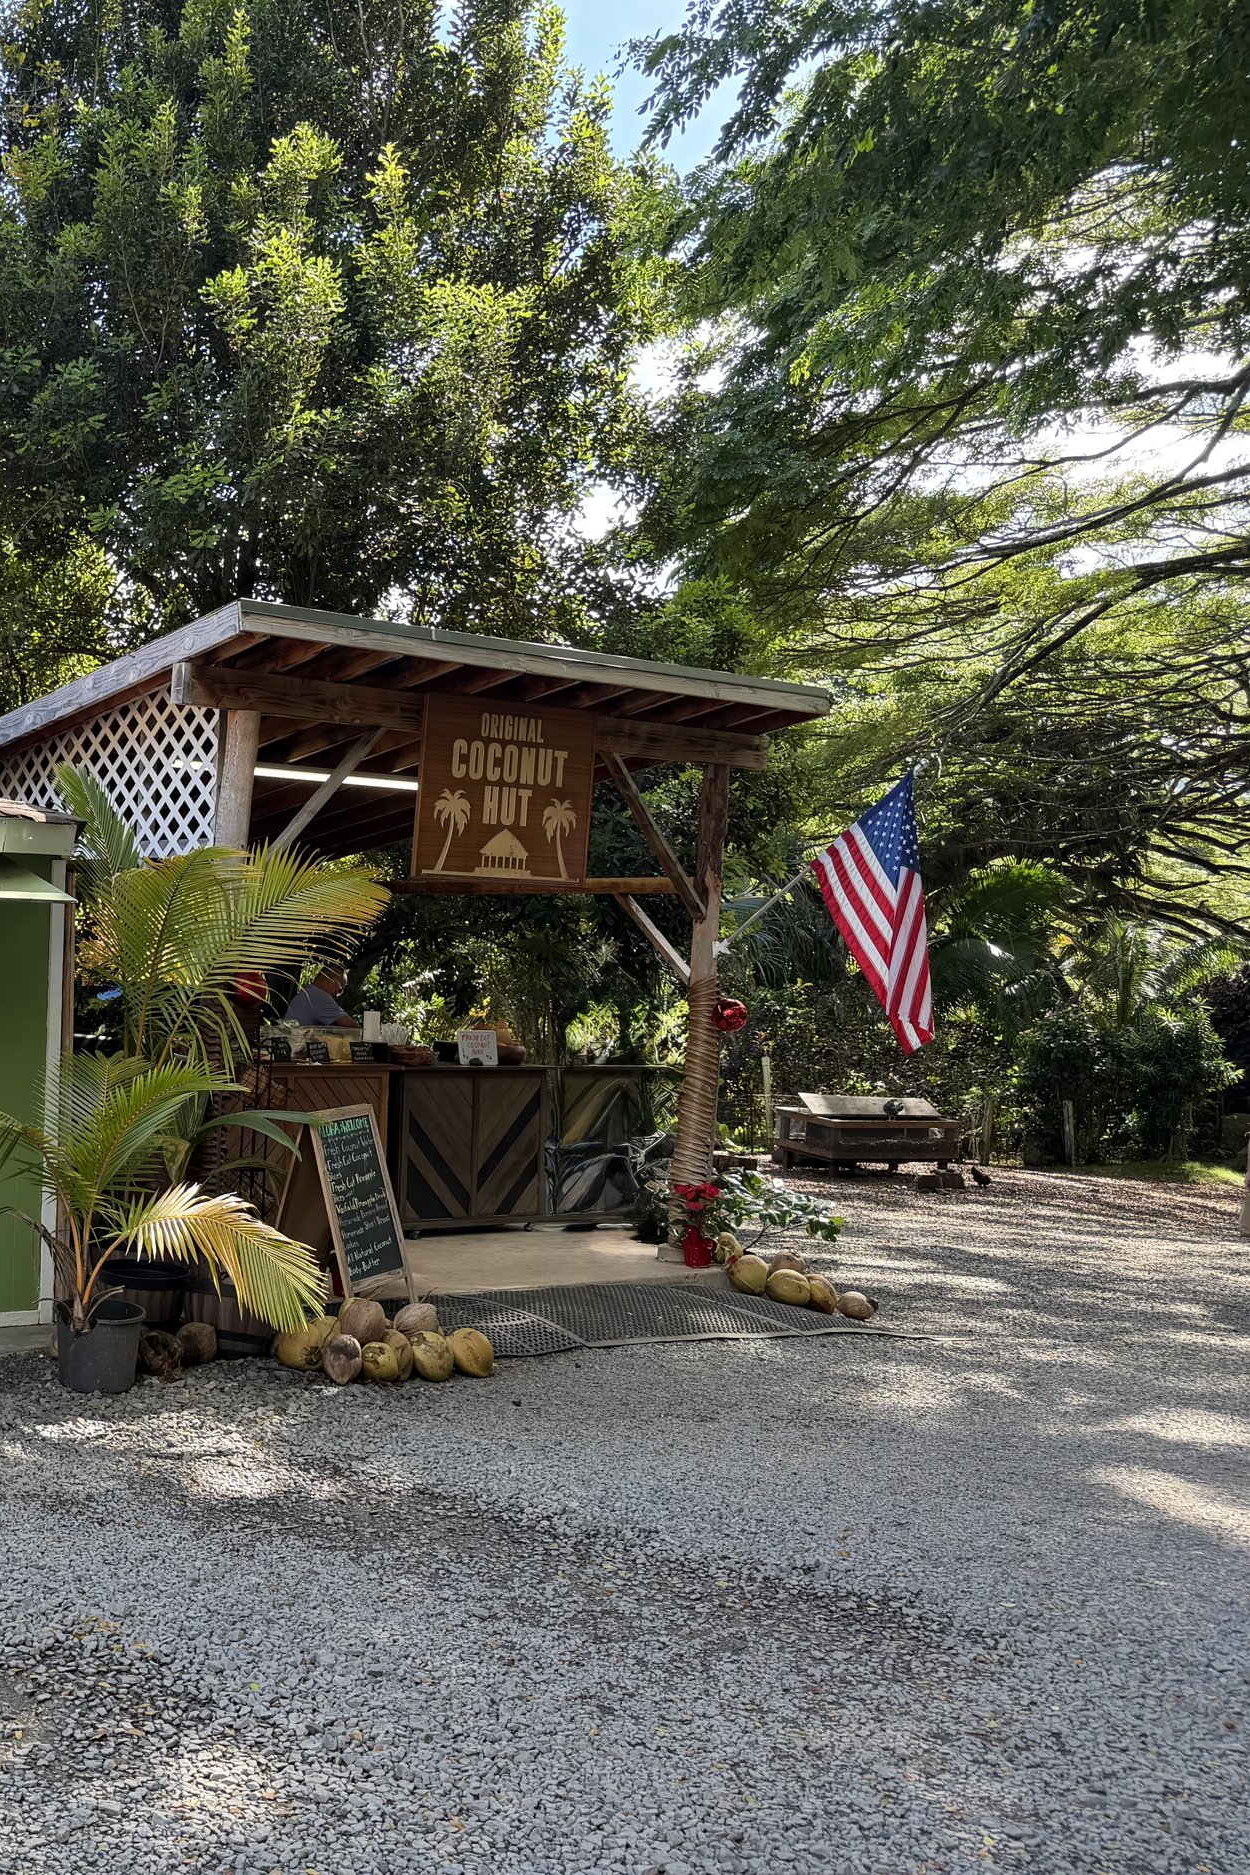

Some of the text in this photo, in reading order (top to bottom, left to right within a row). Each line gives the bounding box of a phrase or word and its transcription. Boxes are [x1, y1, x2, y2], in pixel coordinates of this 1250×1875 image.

[480, 712, 544, 744] ORIGINAL
[451, 738, 569, 788] COCONUT
[482, 785, 533, 827] HUT
[327, 1155, 343, 1171] Fresh
[331, 1179, 347, 1193] Fresh
